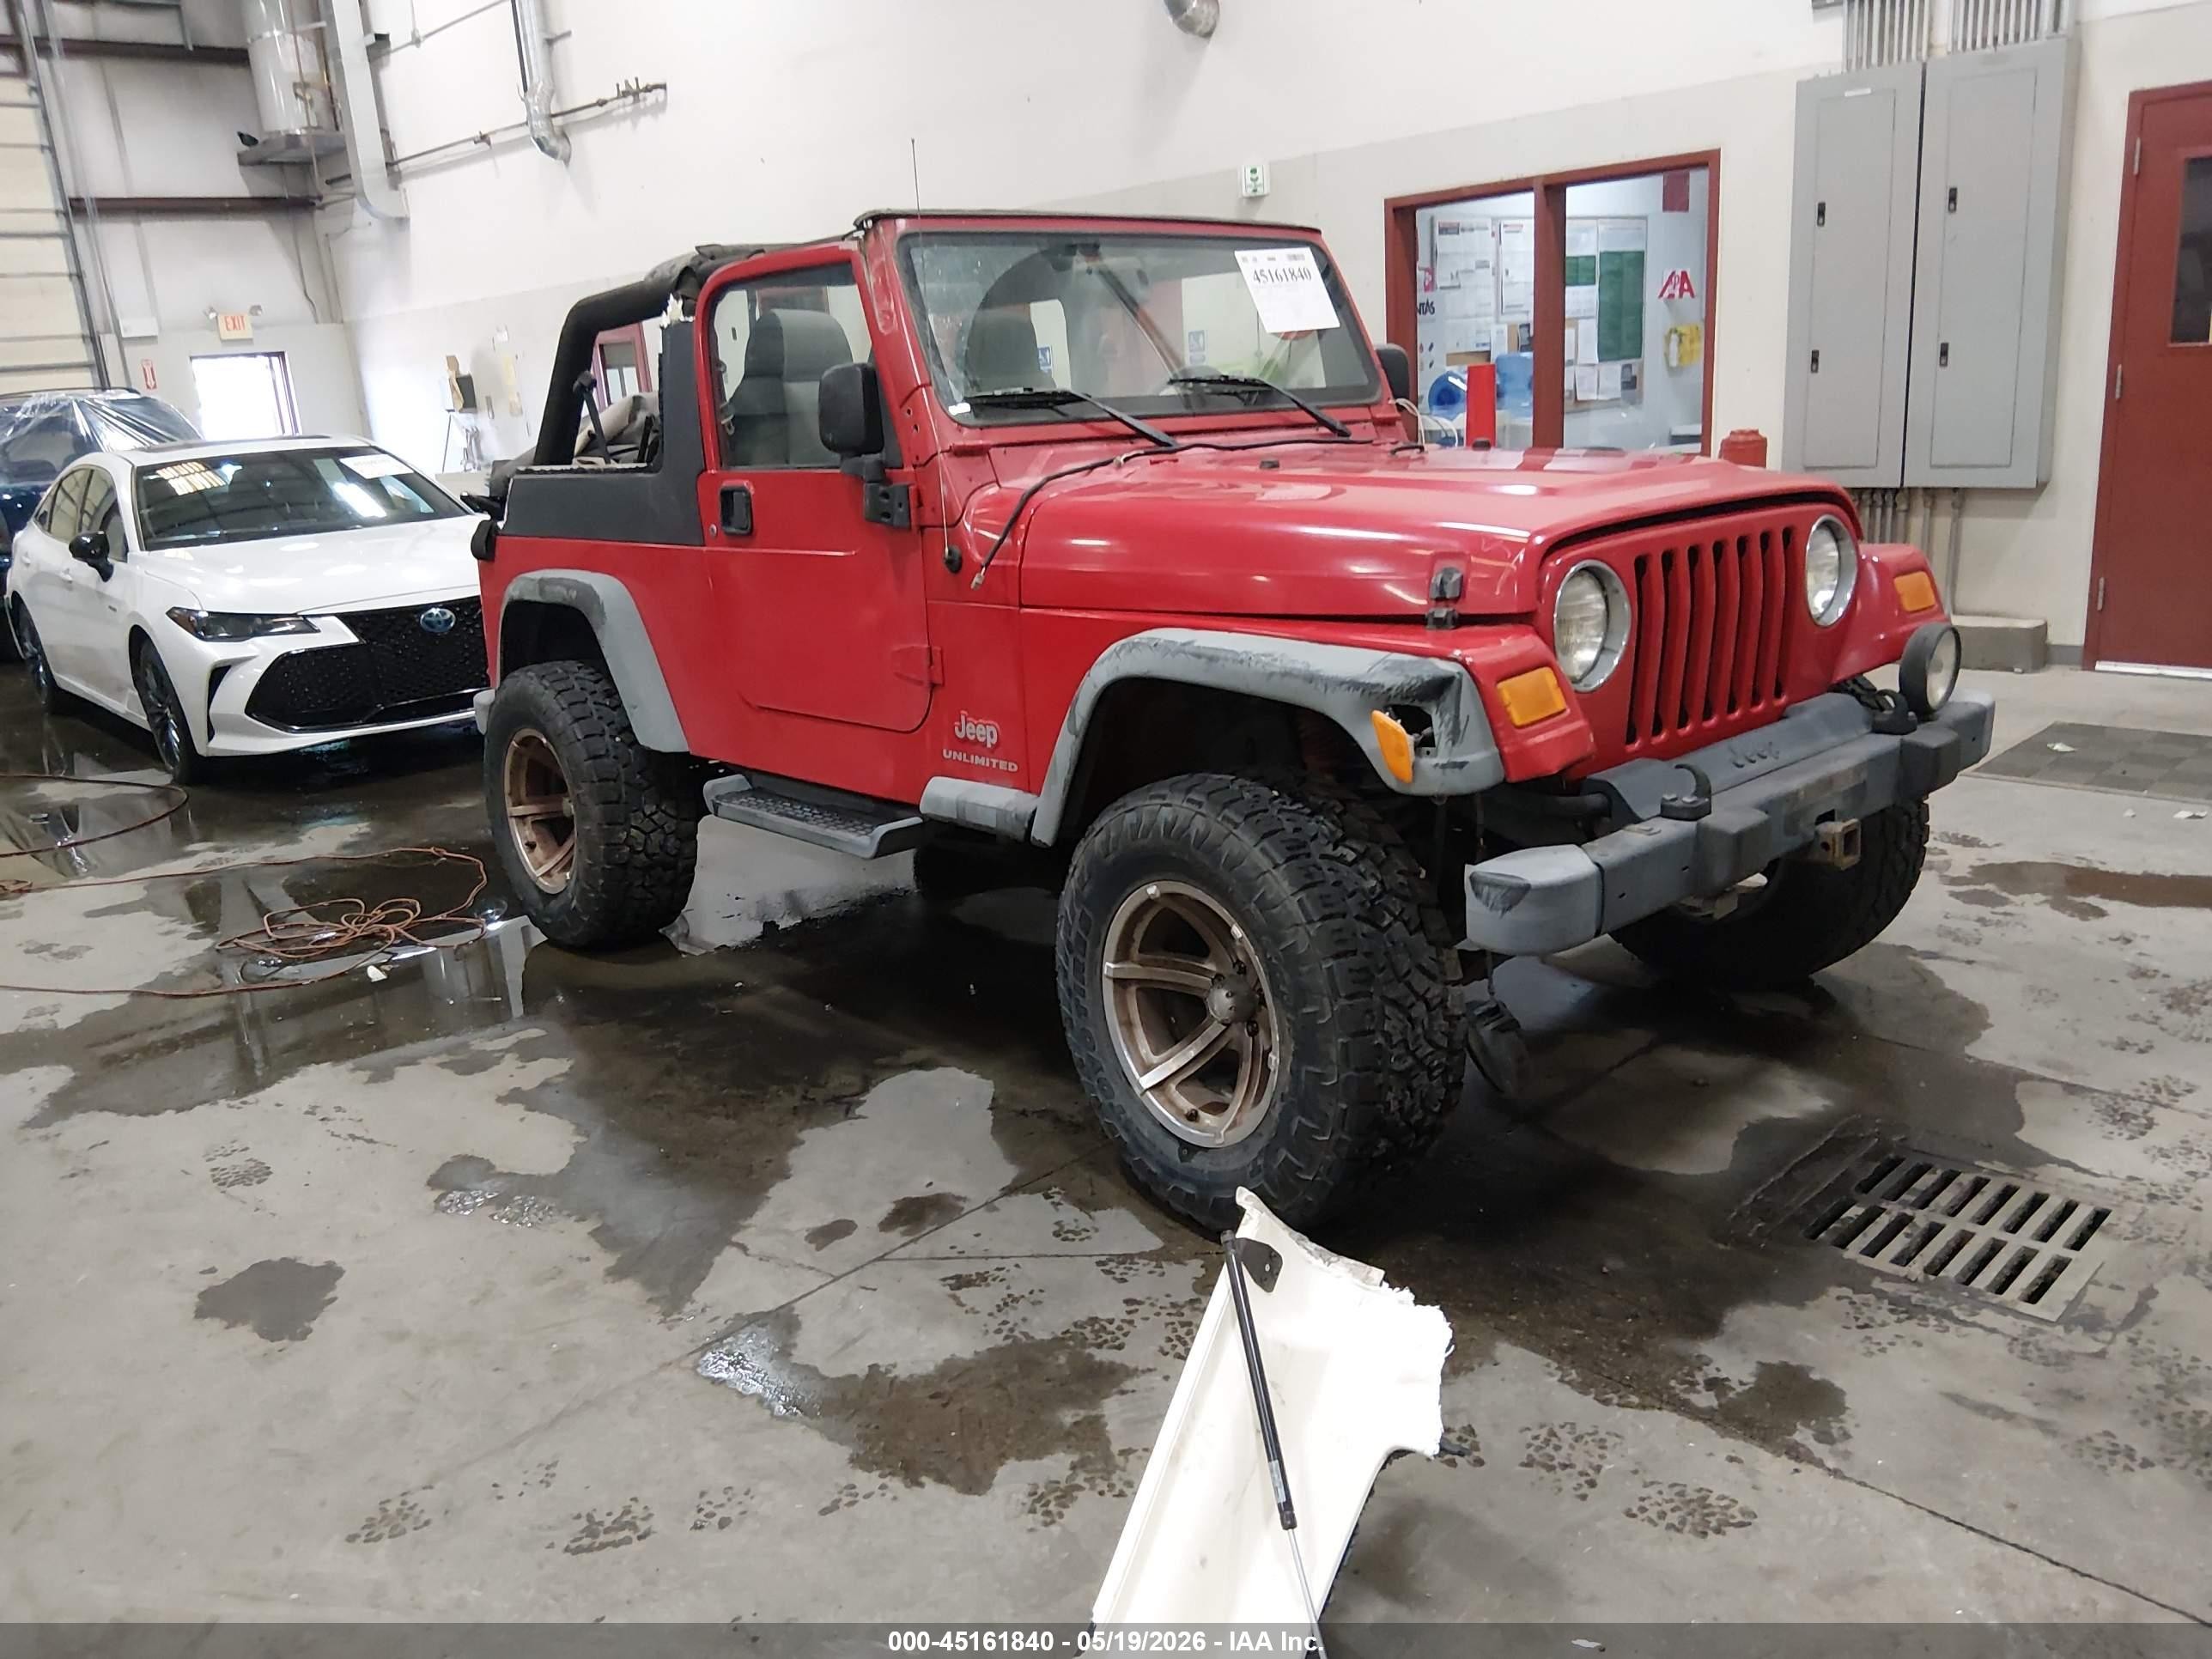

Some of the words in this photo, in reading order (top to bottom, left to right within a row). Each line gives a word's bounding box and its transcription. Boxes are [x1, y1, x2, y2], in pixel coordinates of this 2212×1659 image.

[1253, 267, 1312, 284] 45161840
[224, 315, 246, 331] EXIT
[954, 710, 1000, 748] Jeep
[942, 749, 1018, 772] UNLIMITED
